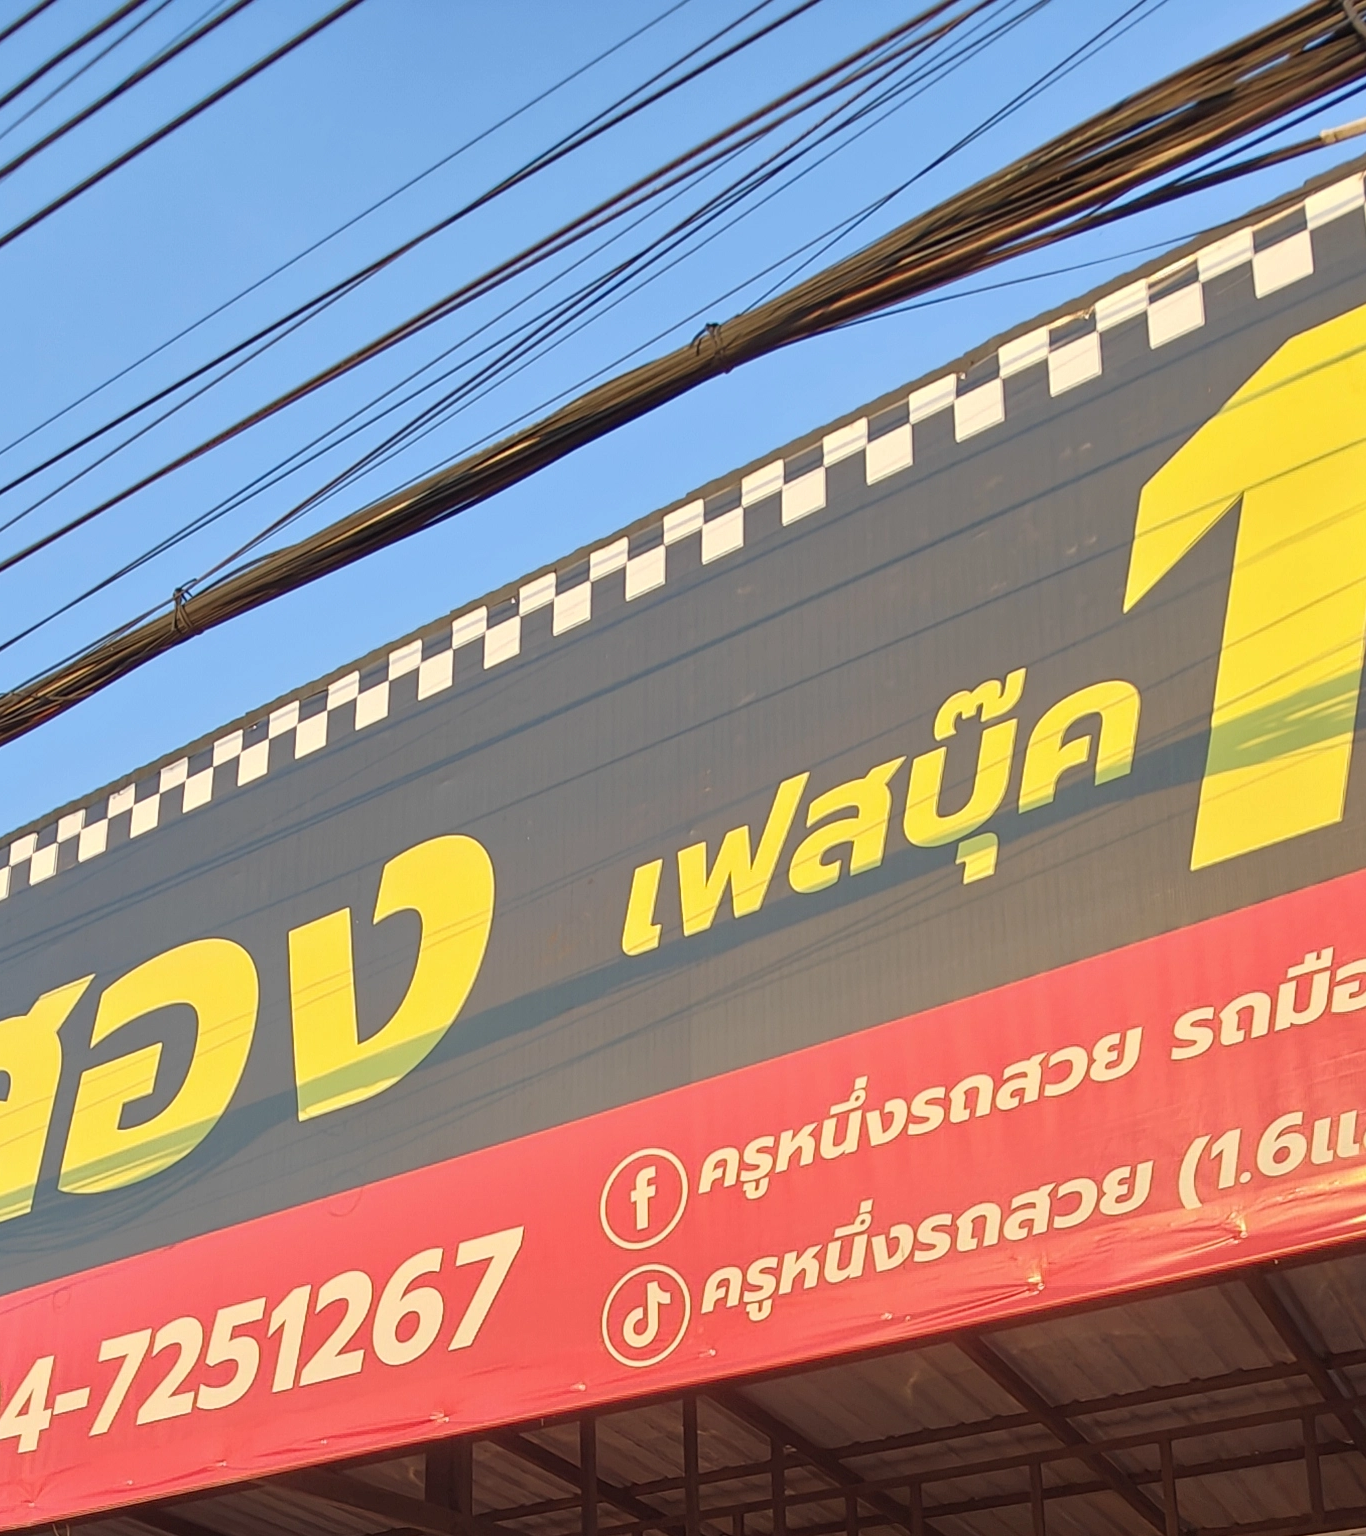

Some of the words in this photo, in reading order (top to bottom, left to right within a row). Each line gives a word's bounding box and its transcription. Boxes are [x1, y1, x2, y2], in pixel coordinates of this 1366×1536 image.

[620, 667, 1143, 957] เฟสบุ๊ค
[698, 1027, 1142, 1199] ครูหนึ่งรถสวย
[701, 1161, 1153, 1321] ครูหนึ่งรถสวย
